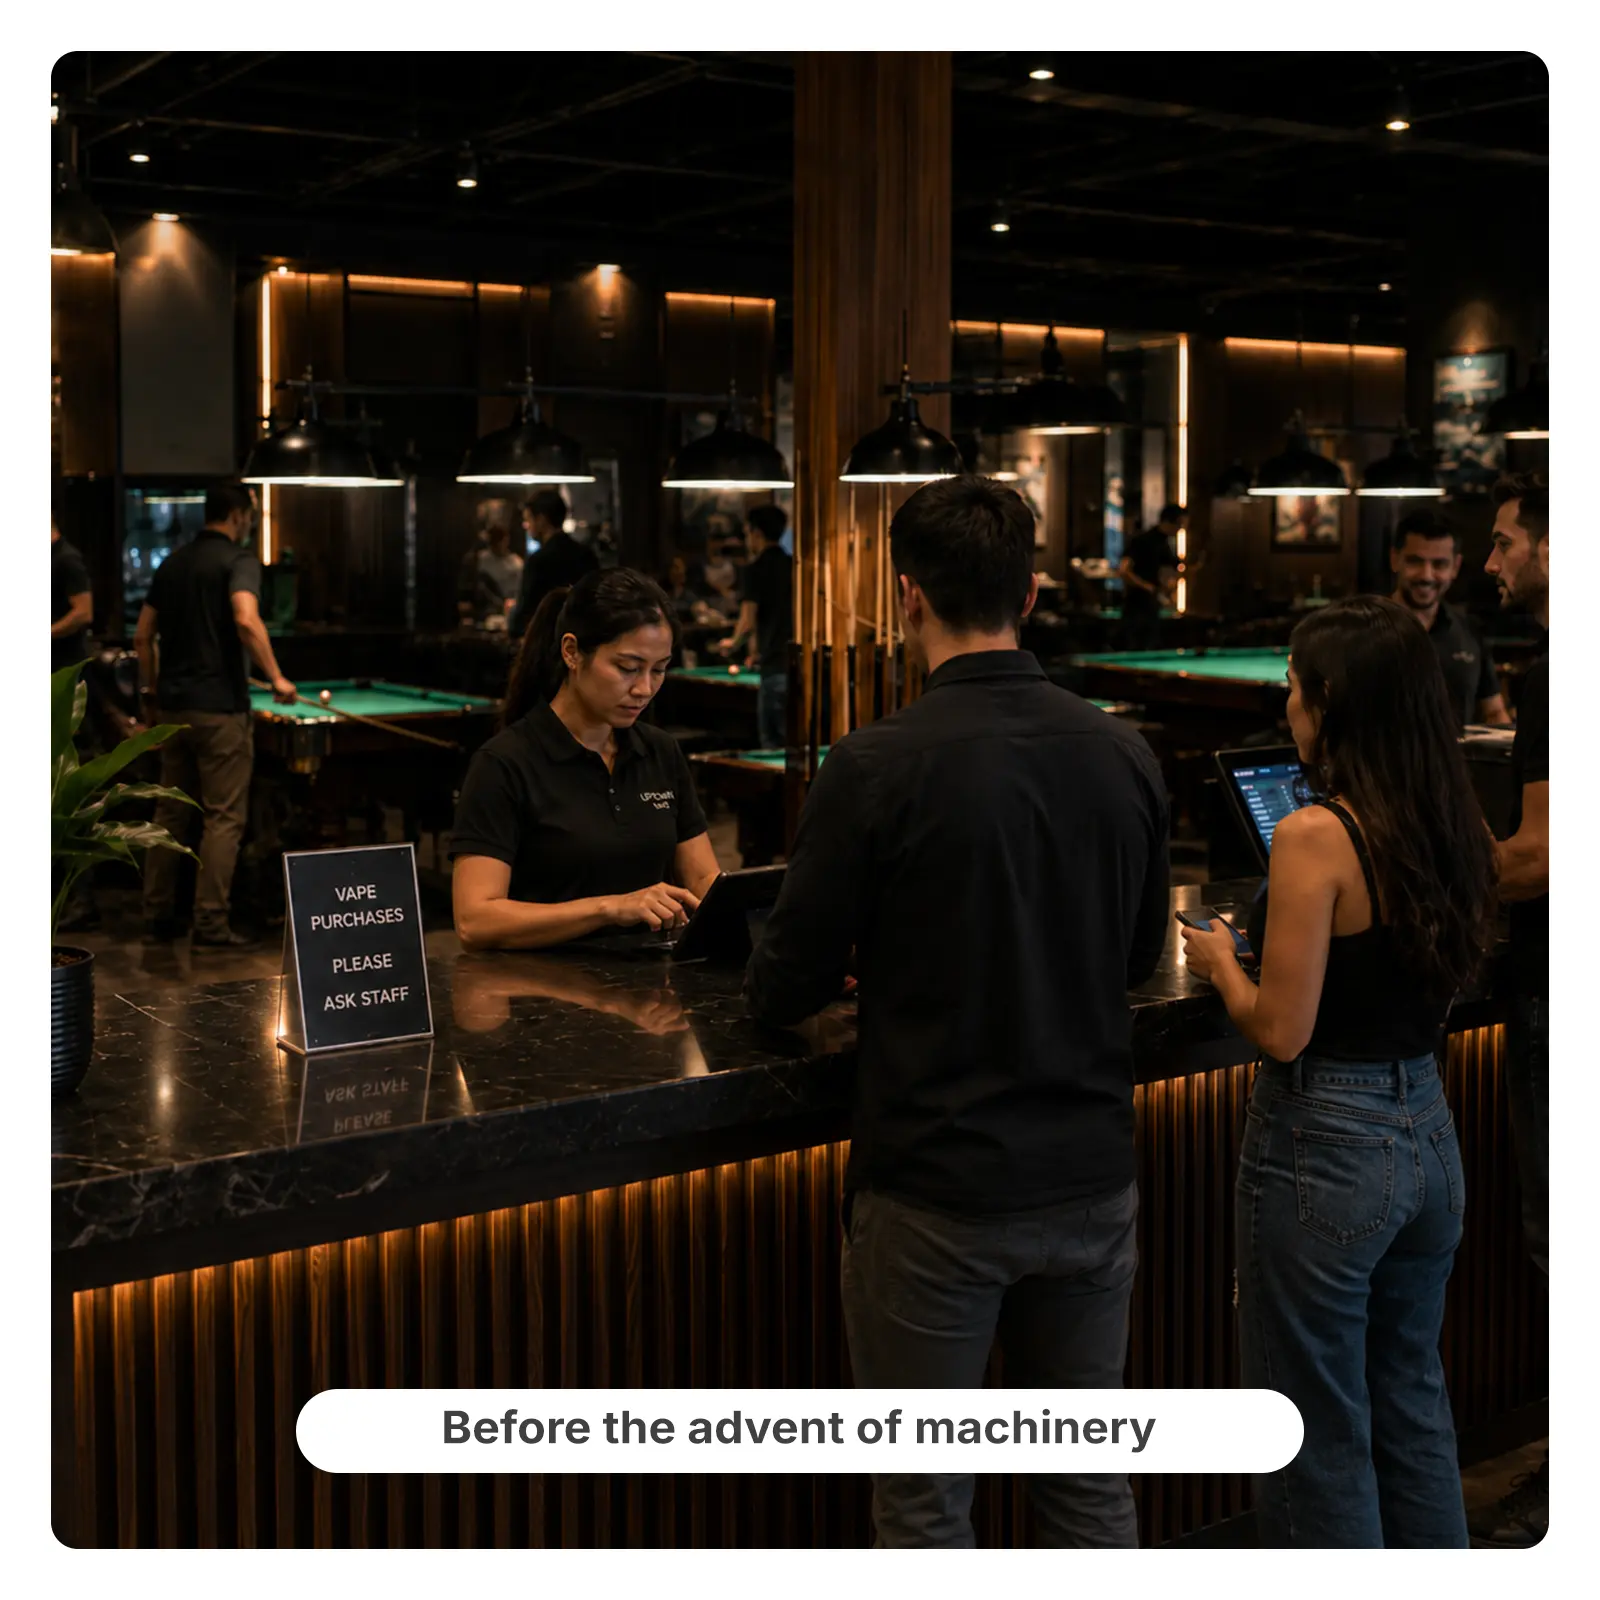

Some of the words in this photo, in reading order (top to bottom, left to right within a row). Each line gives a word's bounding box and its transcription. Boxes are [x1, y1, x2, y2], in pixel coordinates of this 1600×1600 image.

[334, 884, 378, 903] VAPE
[310, 907, 405, 932] PURCHASES
[332, 952, 393, 975] PLEASE
[323, 992, 357, 1012] ASK
[360, 985, 410, 1009] STAFF
